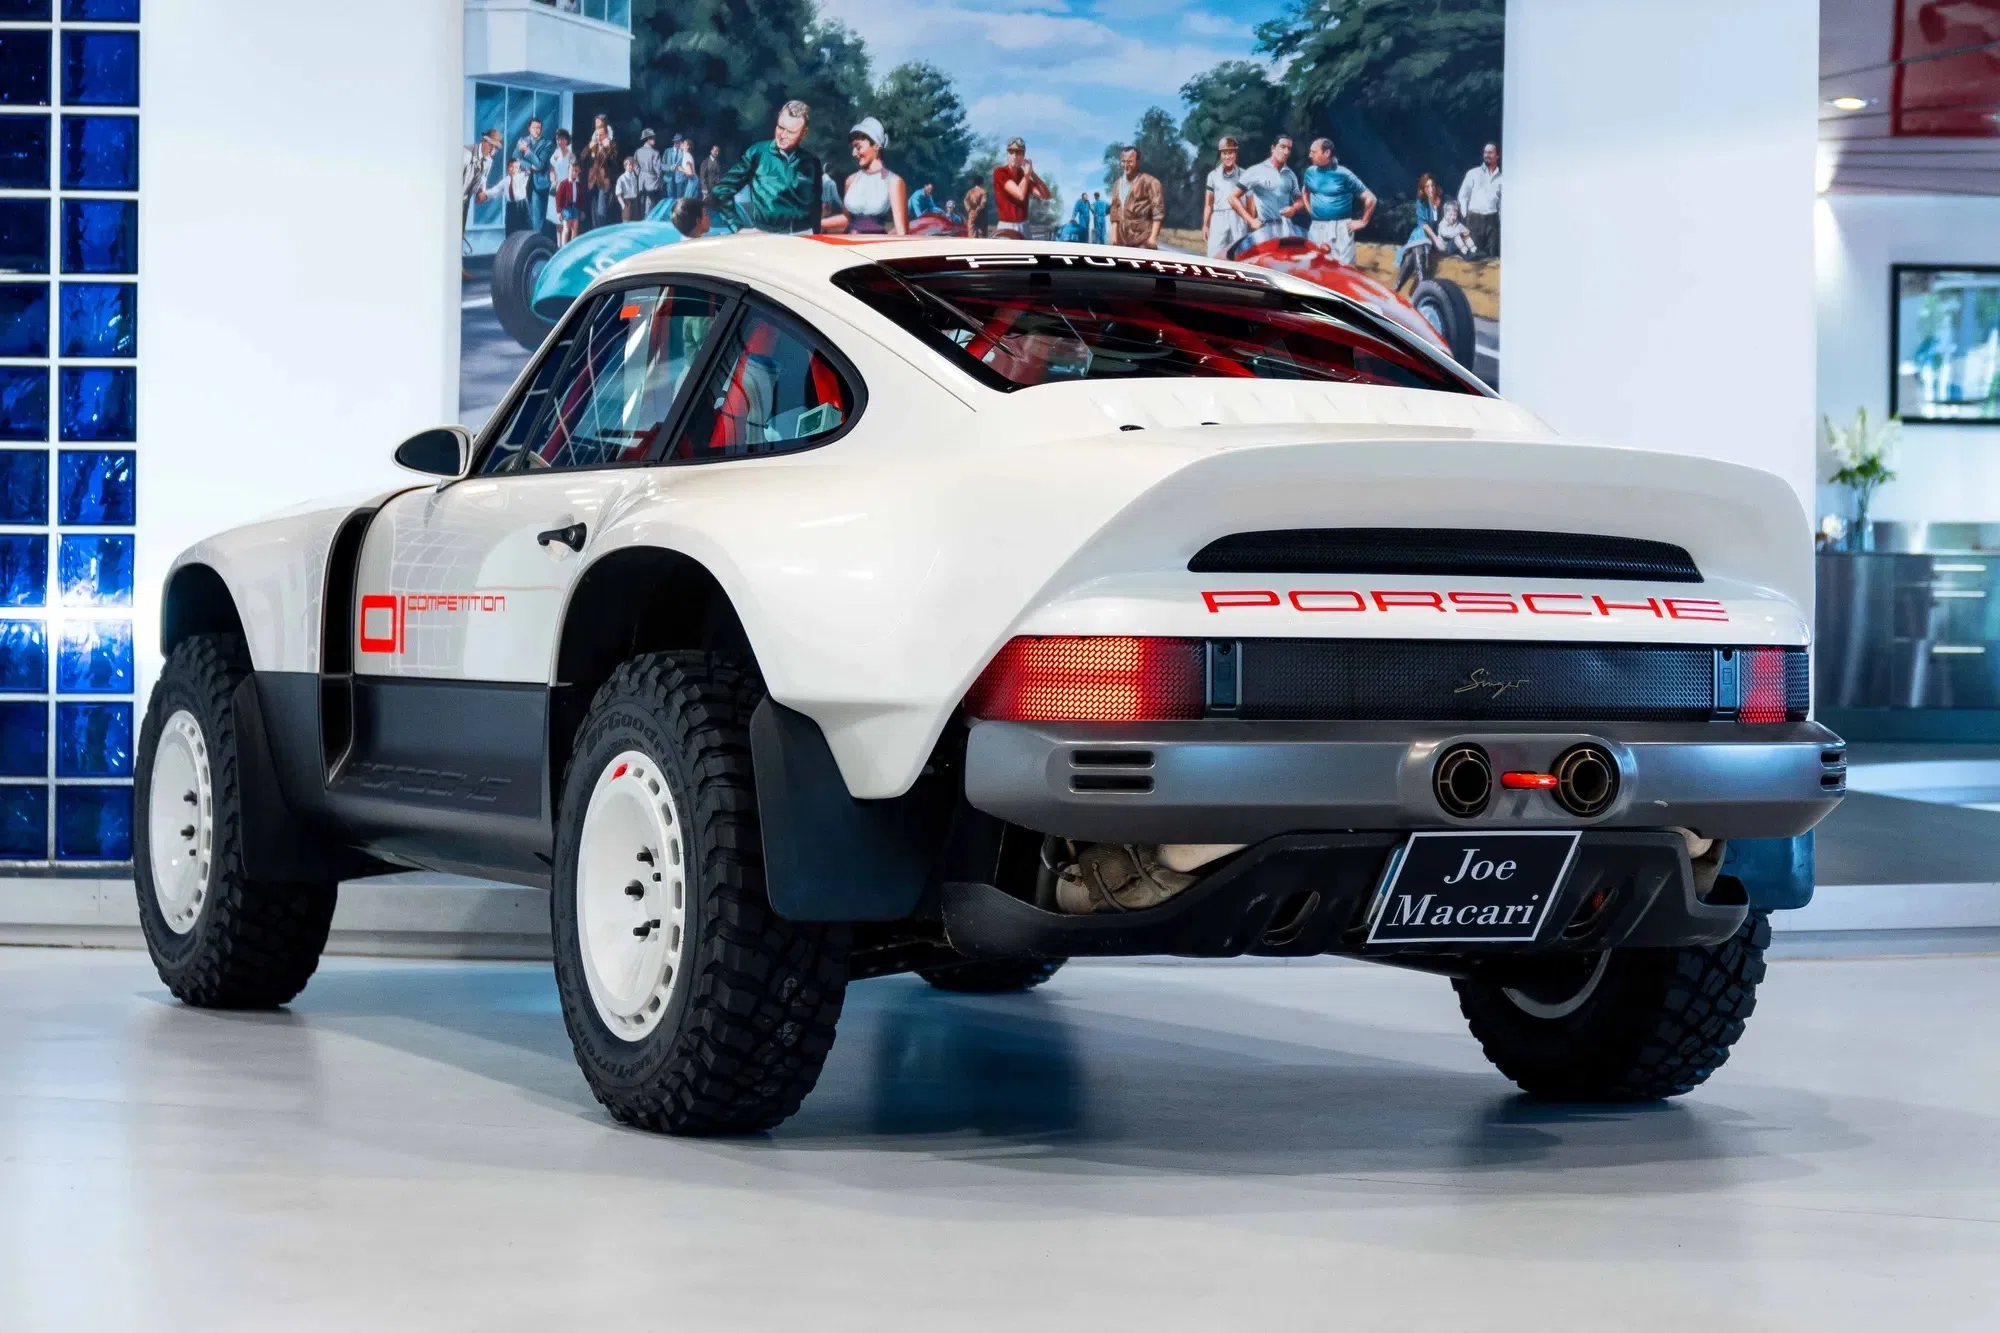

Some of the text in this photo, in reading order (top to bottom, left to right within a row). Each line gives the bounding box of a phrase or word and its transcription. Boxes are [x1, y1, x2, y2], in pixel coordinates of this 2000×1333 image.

[1050, 255, 1271, 285] TUTHILL
[408, 595, 506, 612] COMPETITION
[1201, 590, 1729, 622] PORSCHE
[1454, 668, 1530, 700] Singer
[1443, 848, 1517, 885] Joe
[1386, 893, 1540, 927] Macari
